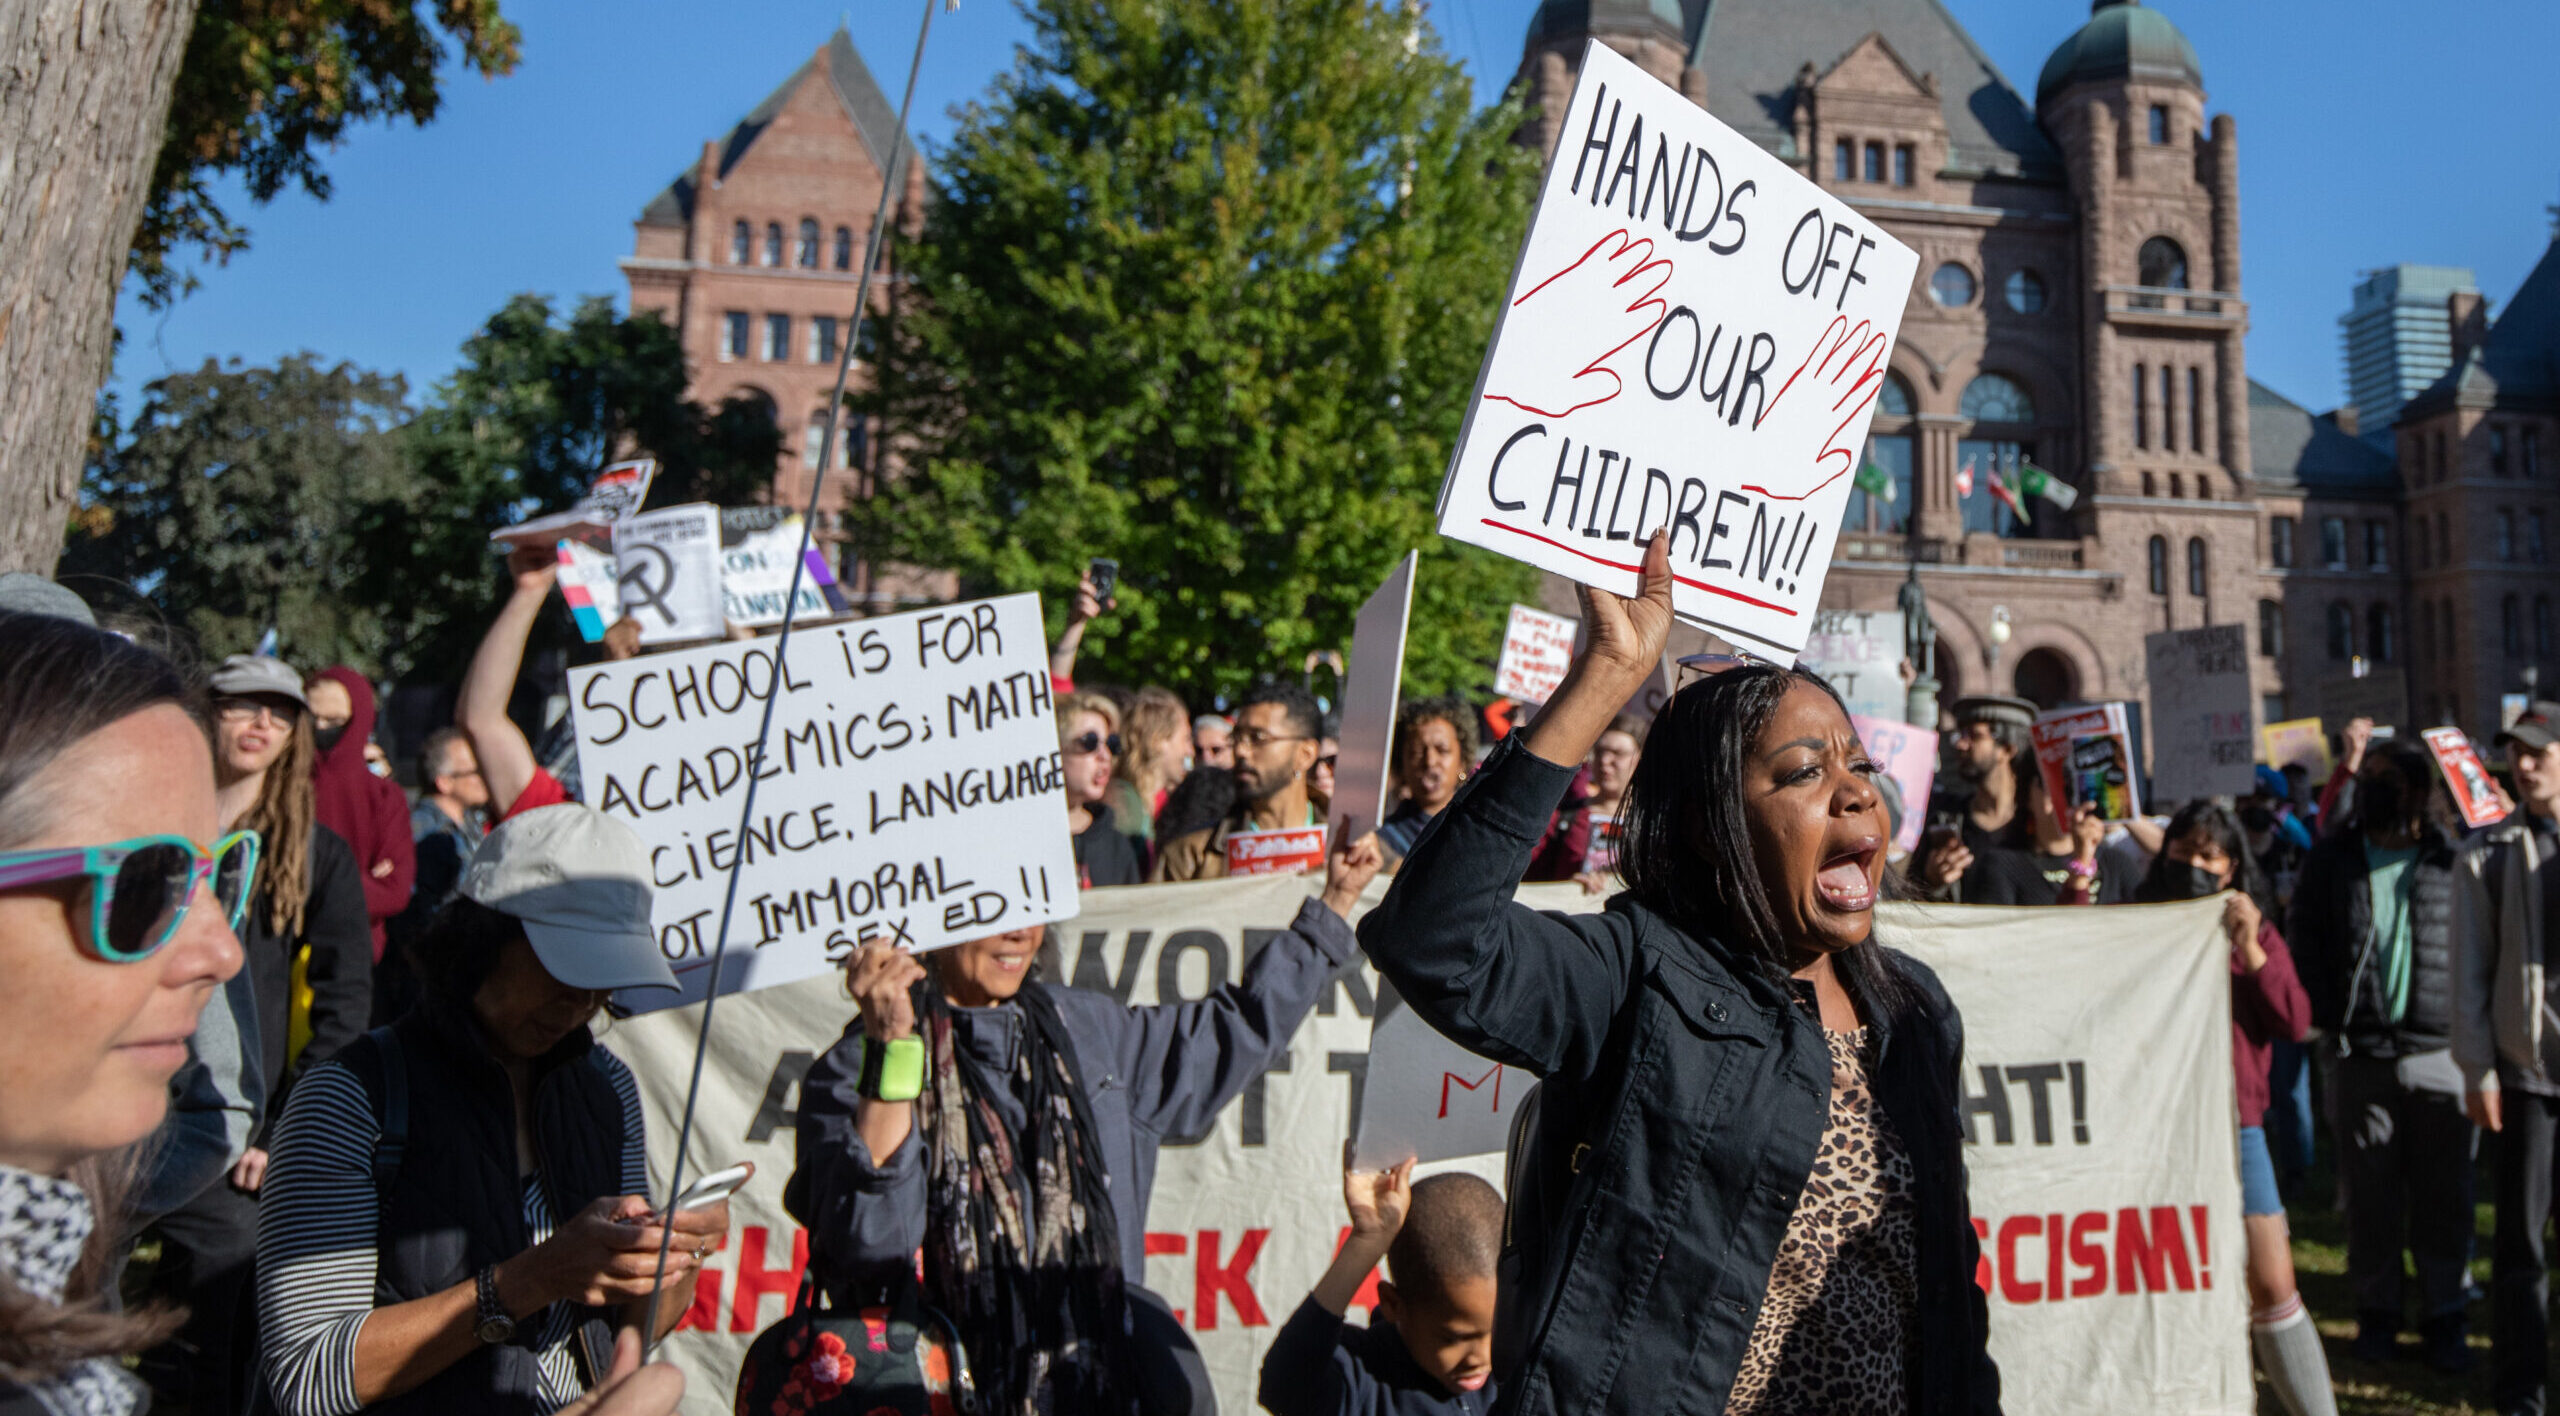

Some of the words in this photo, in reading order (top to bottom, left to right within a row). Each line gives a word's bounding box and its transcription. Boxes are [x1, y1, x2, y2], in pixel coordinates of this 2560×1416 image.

[1570, 81, 1757, 256] HANDS
[1781, 207, 1877, 312] OFF
[1644, 304, 1777, 433] OUR
[1487, 422, 1819, 596] CHILDREN!!
[582, 646, 813, 746] SCHOOL
[917, 603, 1003, 669] FOR
[947, 669, 1053, 739] MATH
[870, 750, 1065, 835] LANGUAGE
[649, 908, 714, 962] OT
[750, 856, 976, 950] IMMORAL
